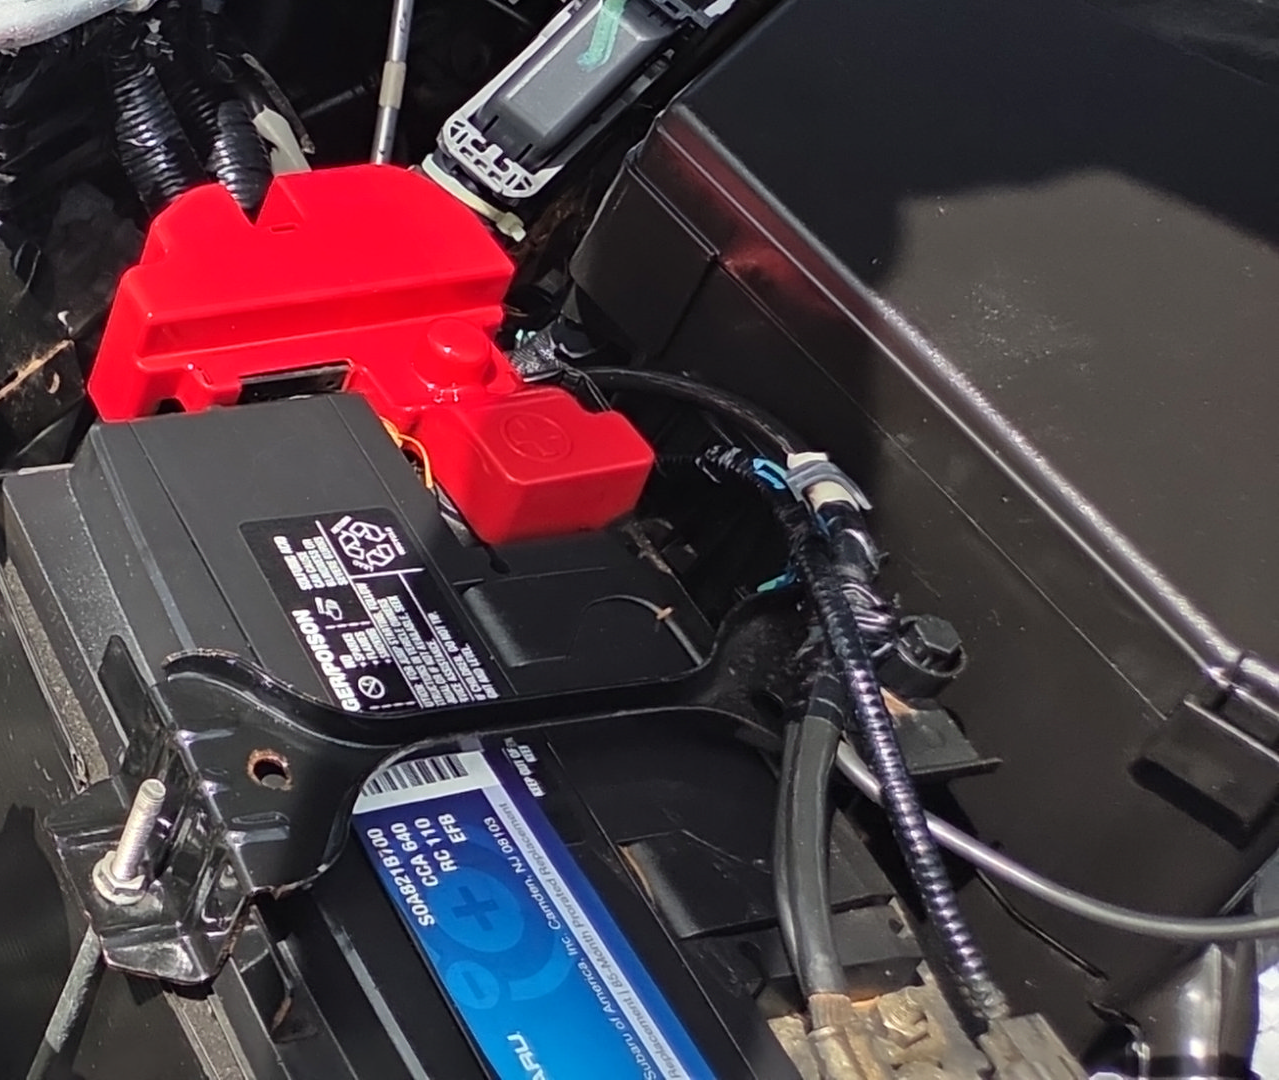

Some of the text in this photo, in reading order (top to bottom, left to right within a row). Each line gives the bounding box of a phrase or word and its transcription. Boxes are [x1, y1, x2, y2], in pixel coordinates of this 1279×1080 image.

[293, 610, 360, 711] GER/POISON
[416, 665, 446, 706] STRUCTIONS
[391, 823, 439, 887] CCA 640
[415, 818, 457, 872] RC 110
[438, 814, 467, 843] EFB
[499, 803, 551, 876] Replacement
[368, 829, 435, 926] SOA821B700
[545, 878, 585, 928] Prorated
[484, 817, 657, 1080] Subaru of America, Inc. Camden, NJ 08103
[582, 931, 623, 988] 85-Month
[623, 997, 681, 1078] Replacement
